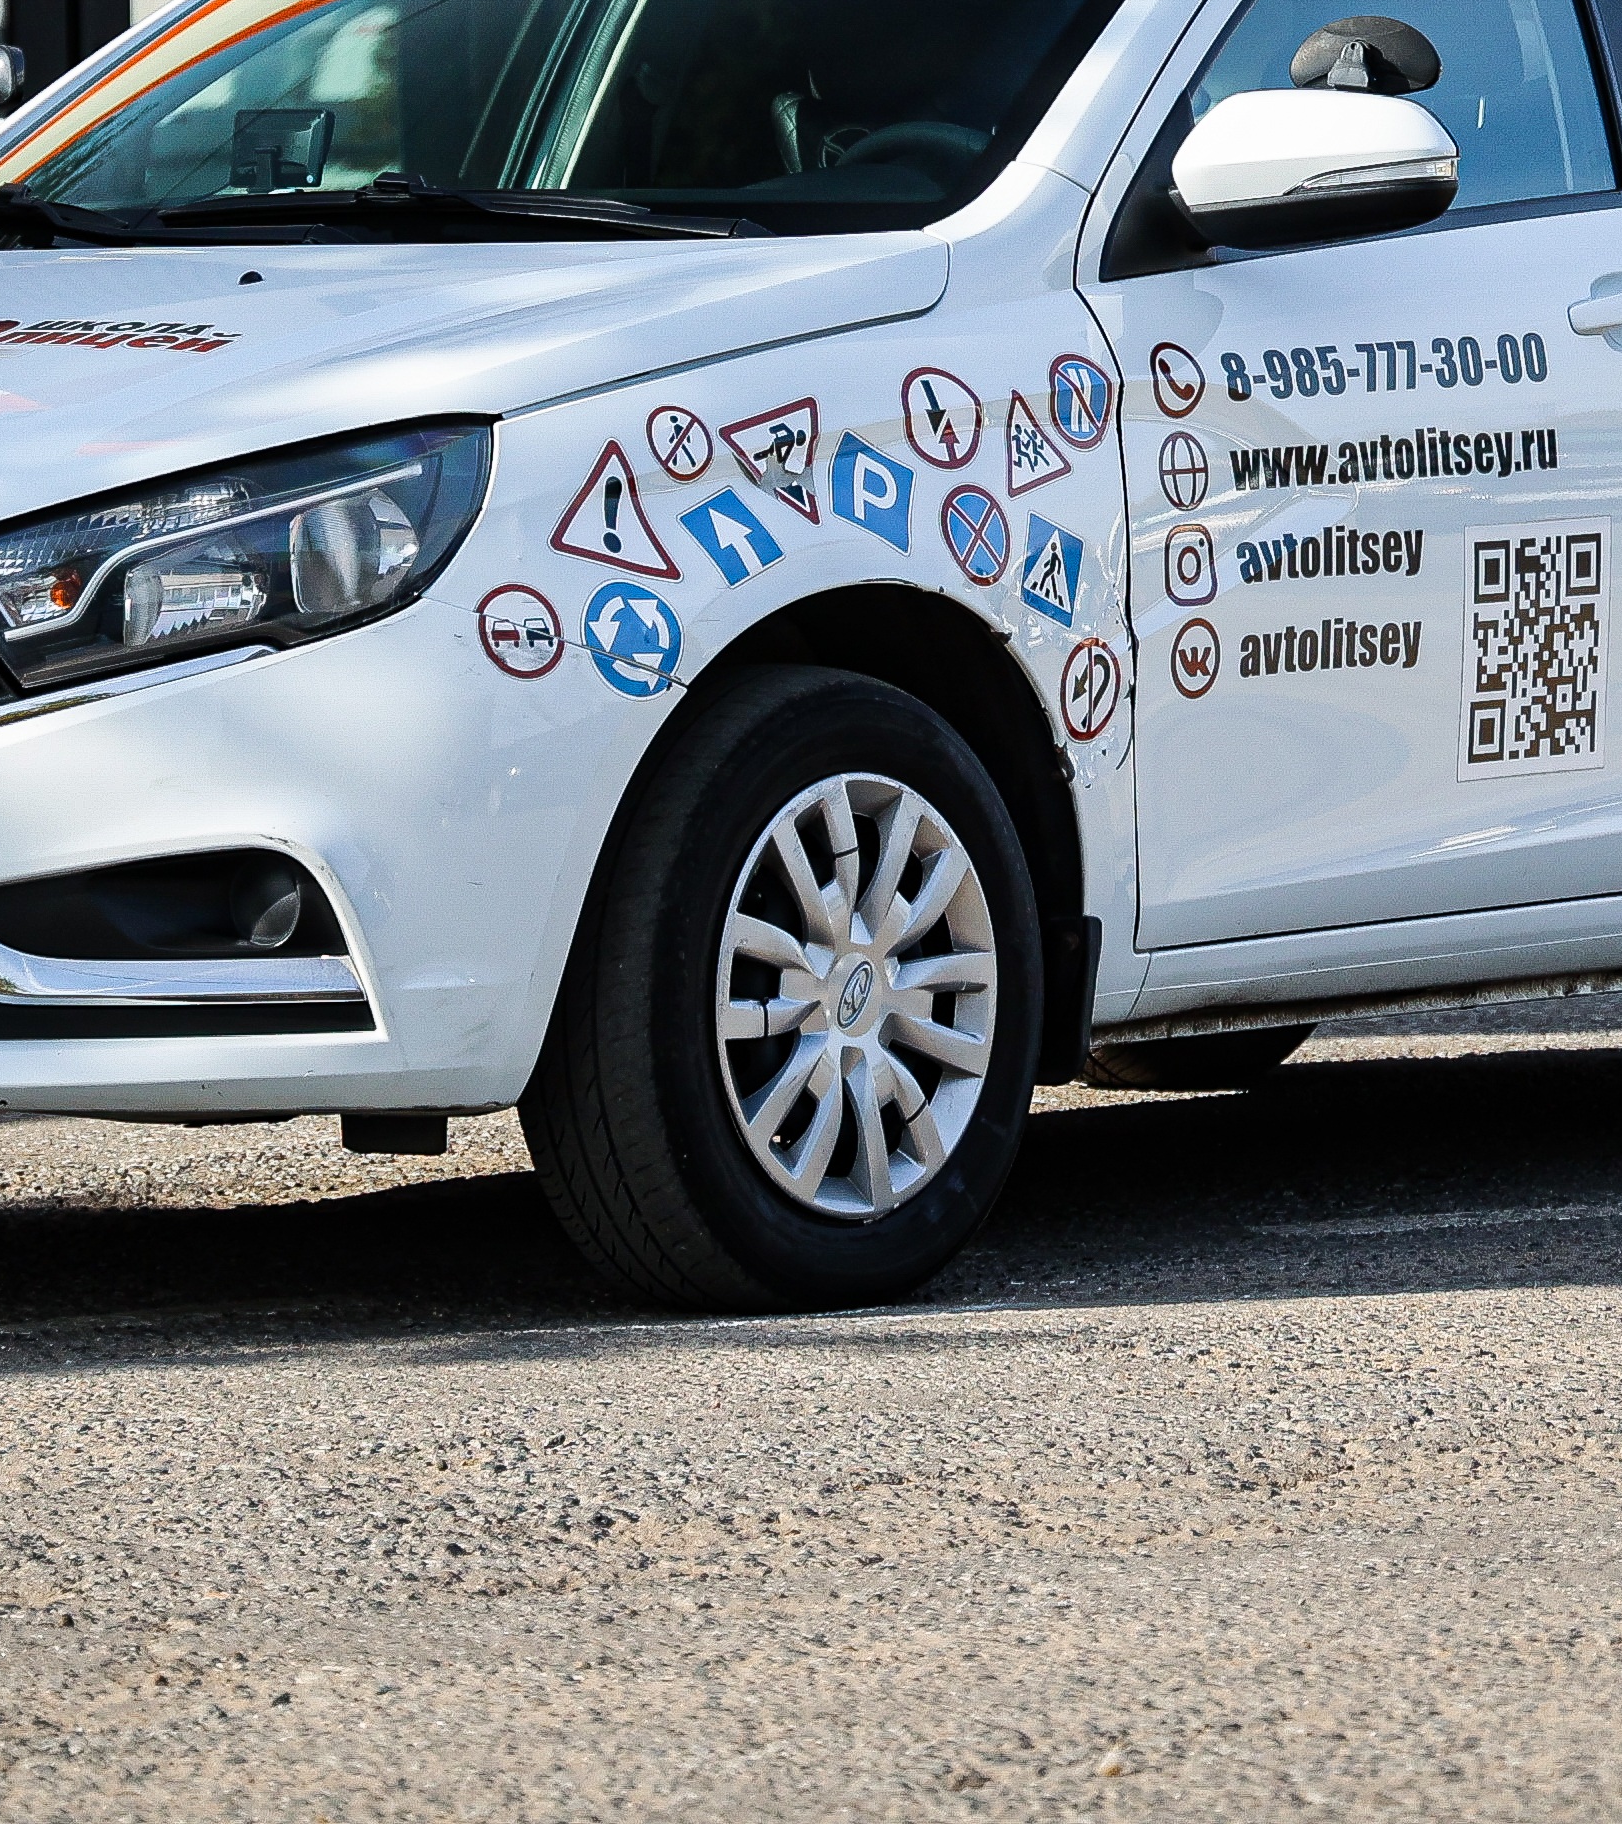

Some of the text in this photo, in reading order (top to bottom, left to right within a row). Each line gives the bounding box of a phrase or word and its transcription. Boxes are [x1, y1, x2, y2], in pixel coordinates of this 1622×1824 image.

[32, 319, 216, 335] ШКОЛА
[1220, 331, 1550, 402] 8-985-777-30-00
[1229, 427, 1559, 491] www.avtolitsey.ru
[1235, 524, 1425, 585] avtolitsey
[1238, 617, 1423, 678] avtolitsey
